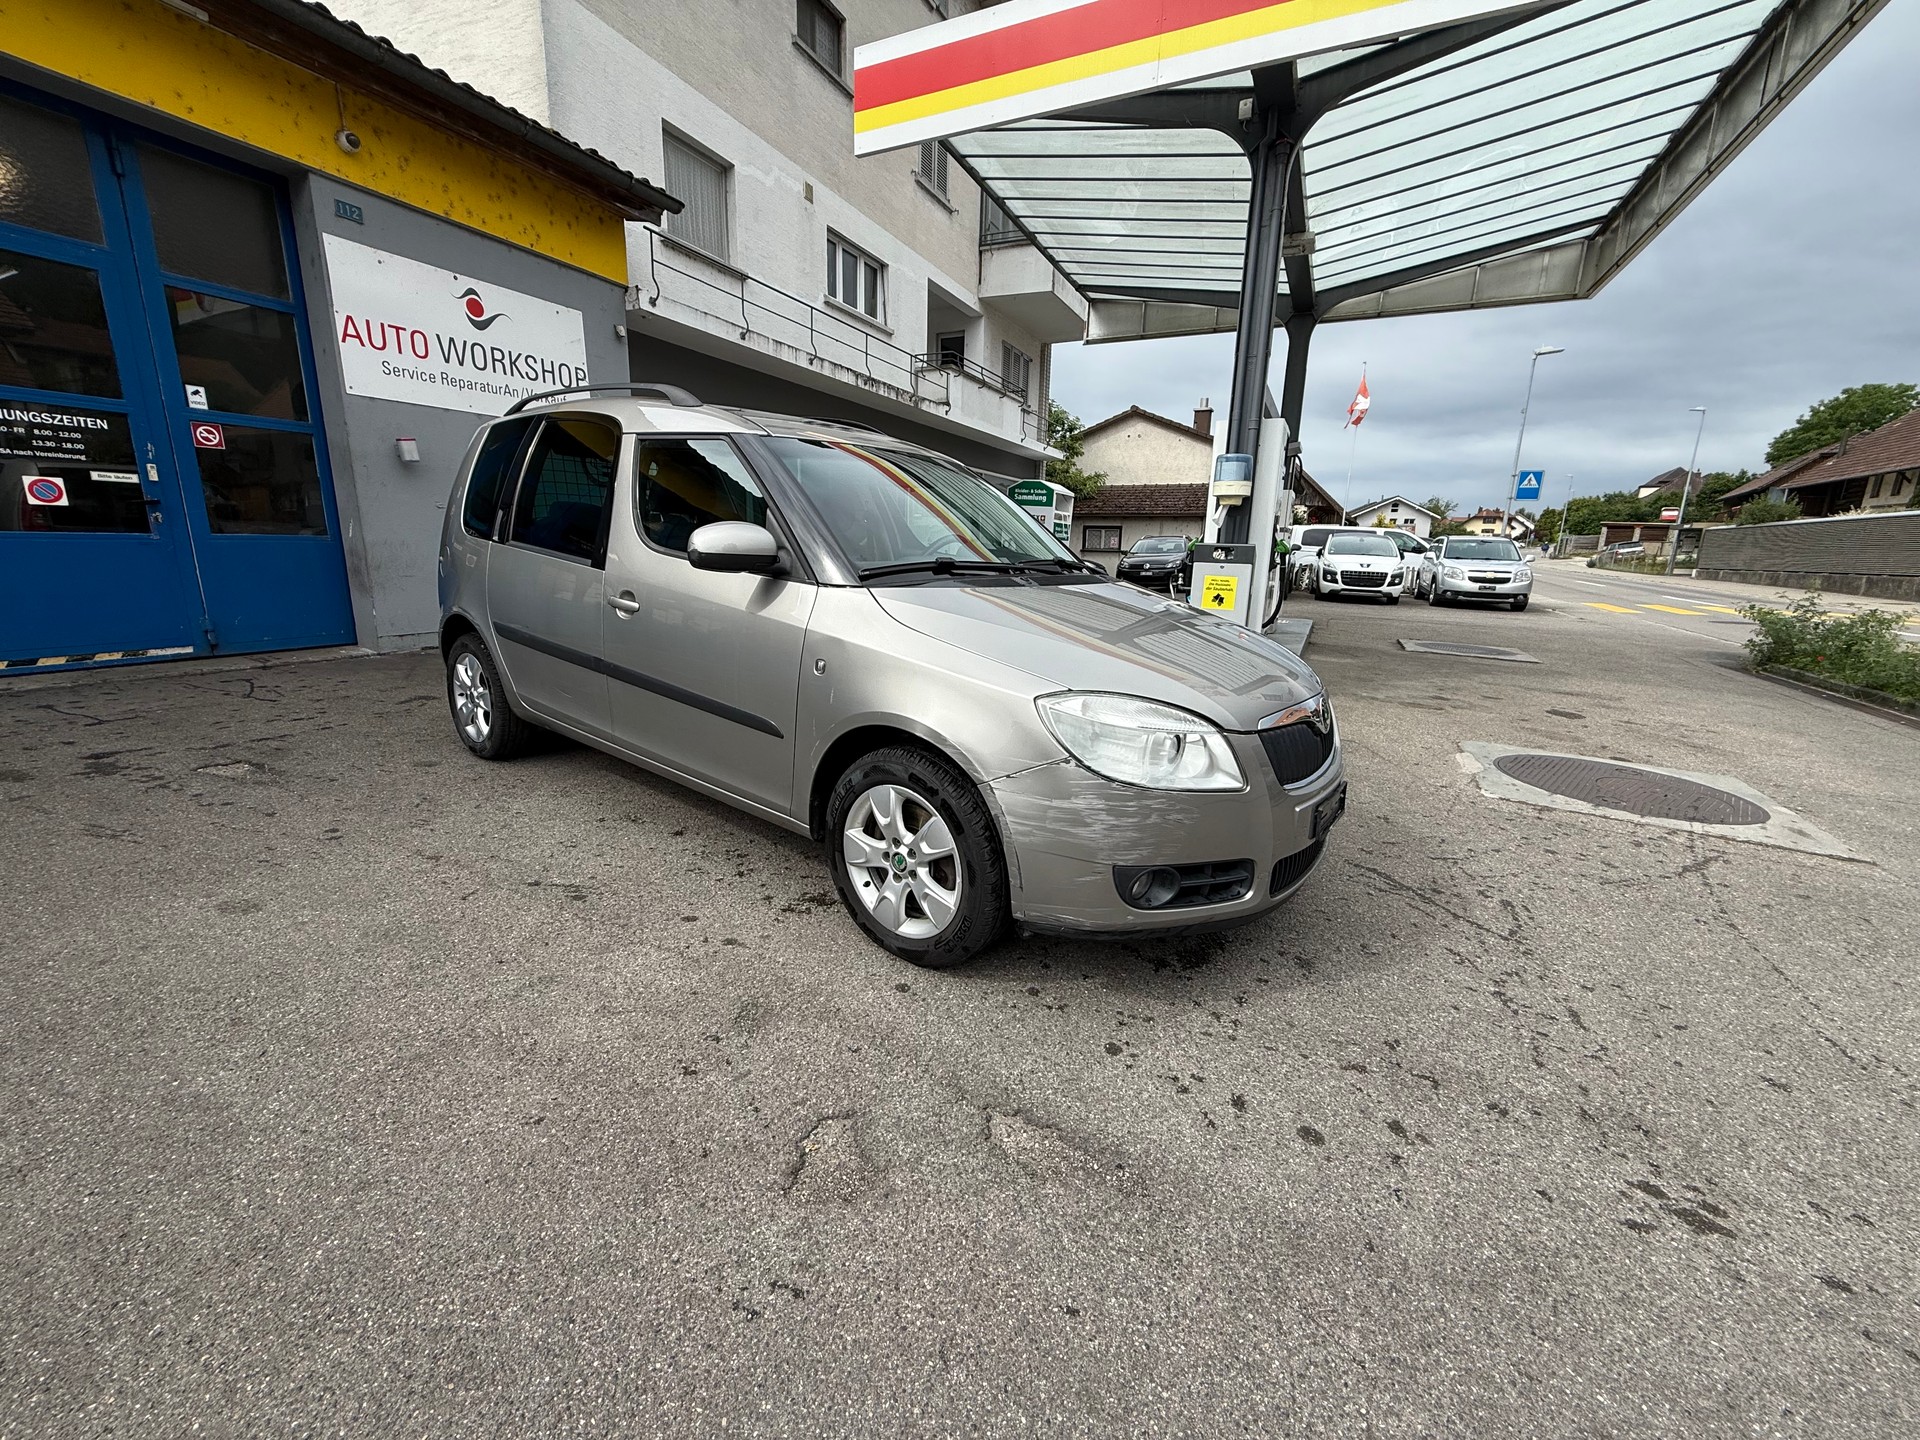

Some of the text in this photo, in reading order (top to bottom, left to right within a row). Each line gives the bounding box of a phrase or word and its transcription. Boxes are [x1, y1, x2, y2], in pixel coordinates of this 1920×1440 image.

[338, 202, 360, 220] 112
[341, 315, 587, 389] AUTO WORKSHOP
[381, 360, 437, 384] Service
[13, 426, 26, 434] FR
[33, 428, 53, 436] 8.00
[58, 431, 82, 439] 12.00
[31, 439, 56, 448] 13.30
[62, 442, 85, 450] 18.00
[34, 450, 87, 461] Vereinbarung
[1014, 493, 1047, 502] Sammlung
